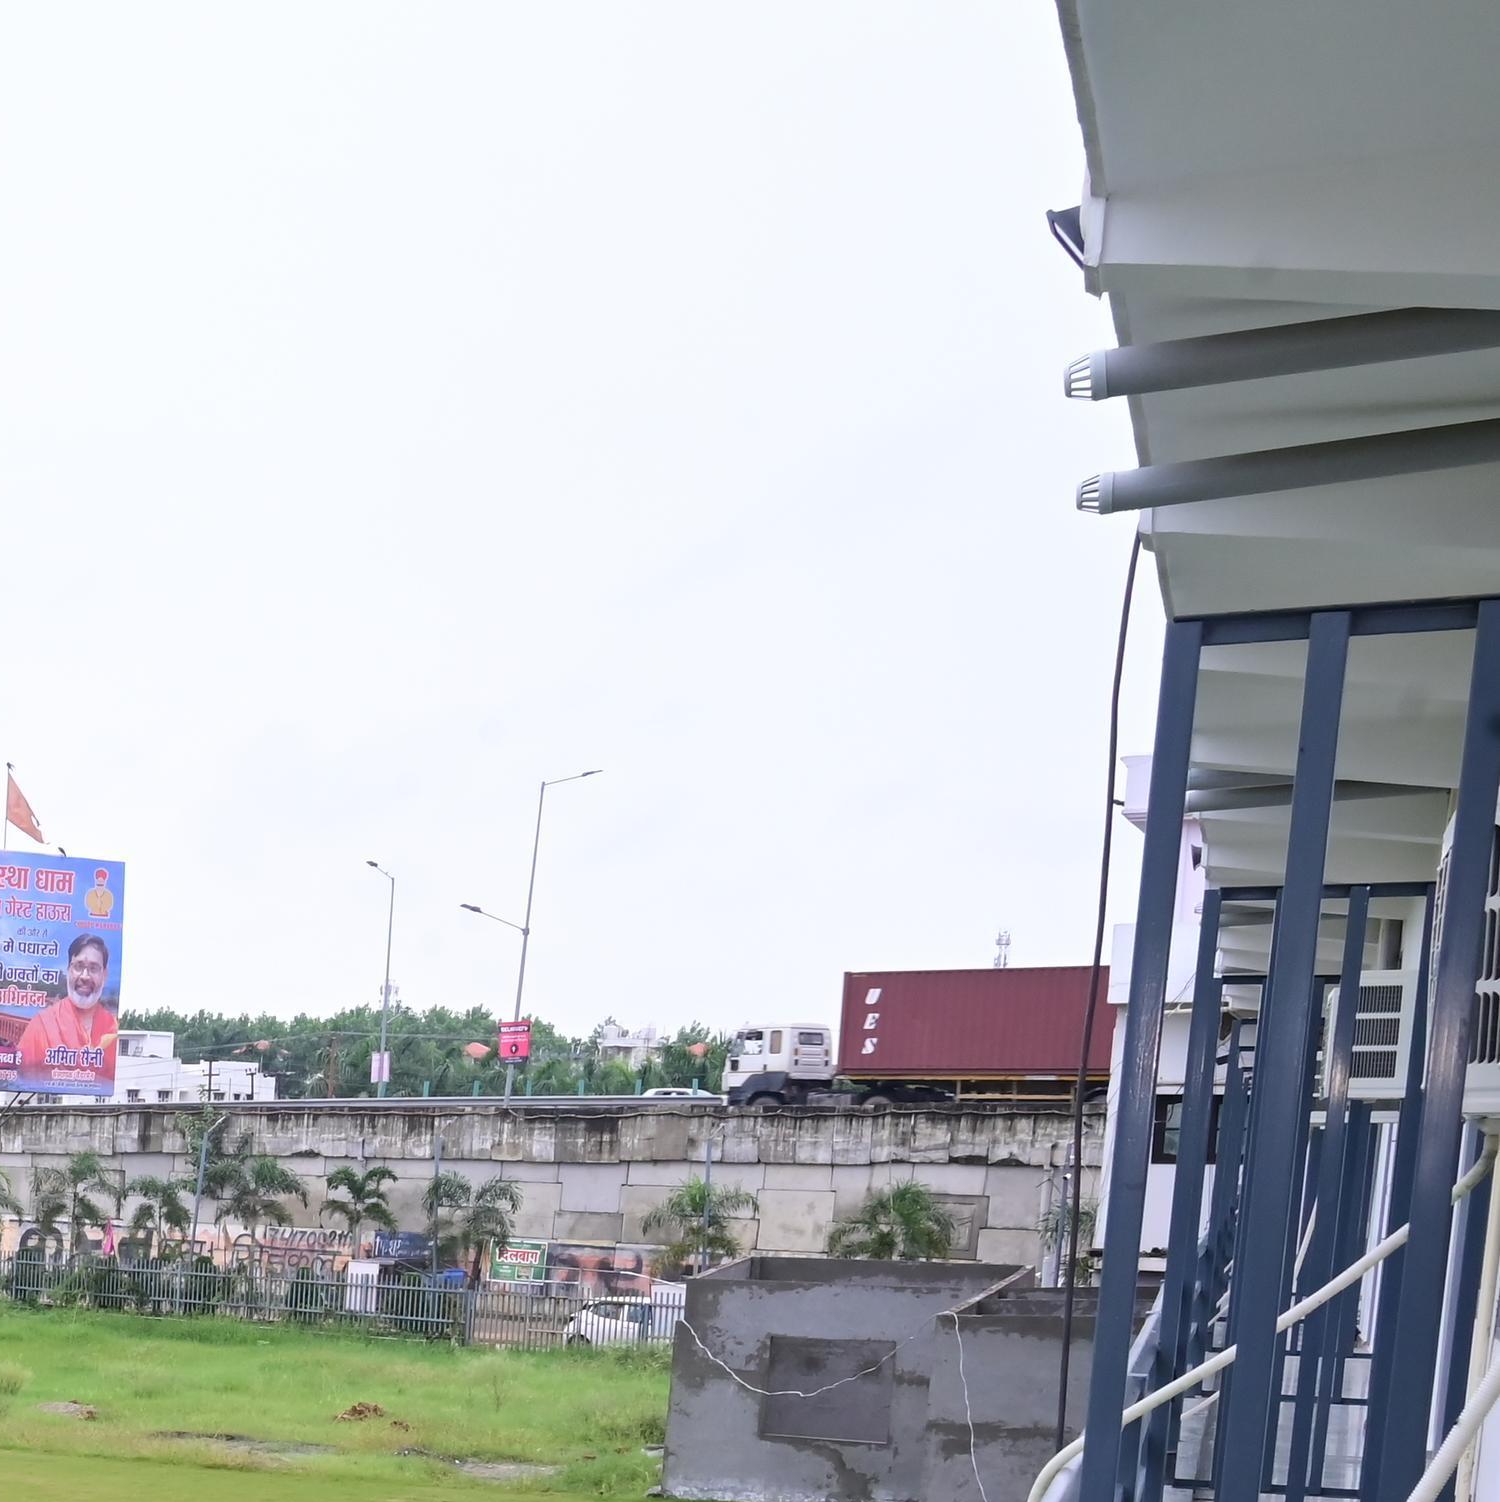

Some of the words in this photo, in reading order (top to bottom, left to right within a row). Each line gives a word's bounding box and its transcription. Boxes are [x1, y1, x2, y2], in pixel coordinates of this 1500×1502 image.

[35, 869, 75, 894] धाम
[5, 896, 33, 918] गेस्ट
[18, 940, 59, 956] पधारने
[42, 969, 59, 984] का
[15, 1051, 22, 1065] है
[45, 1045, 77, 1066] अमित
[80, 1046, 104, 1067] सैनी
